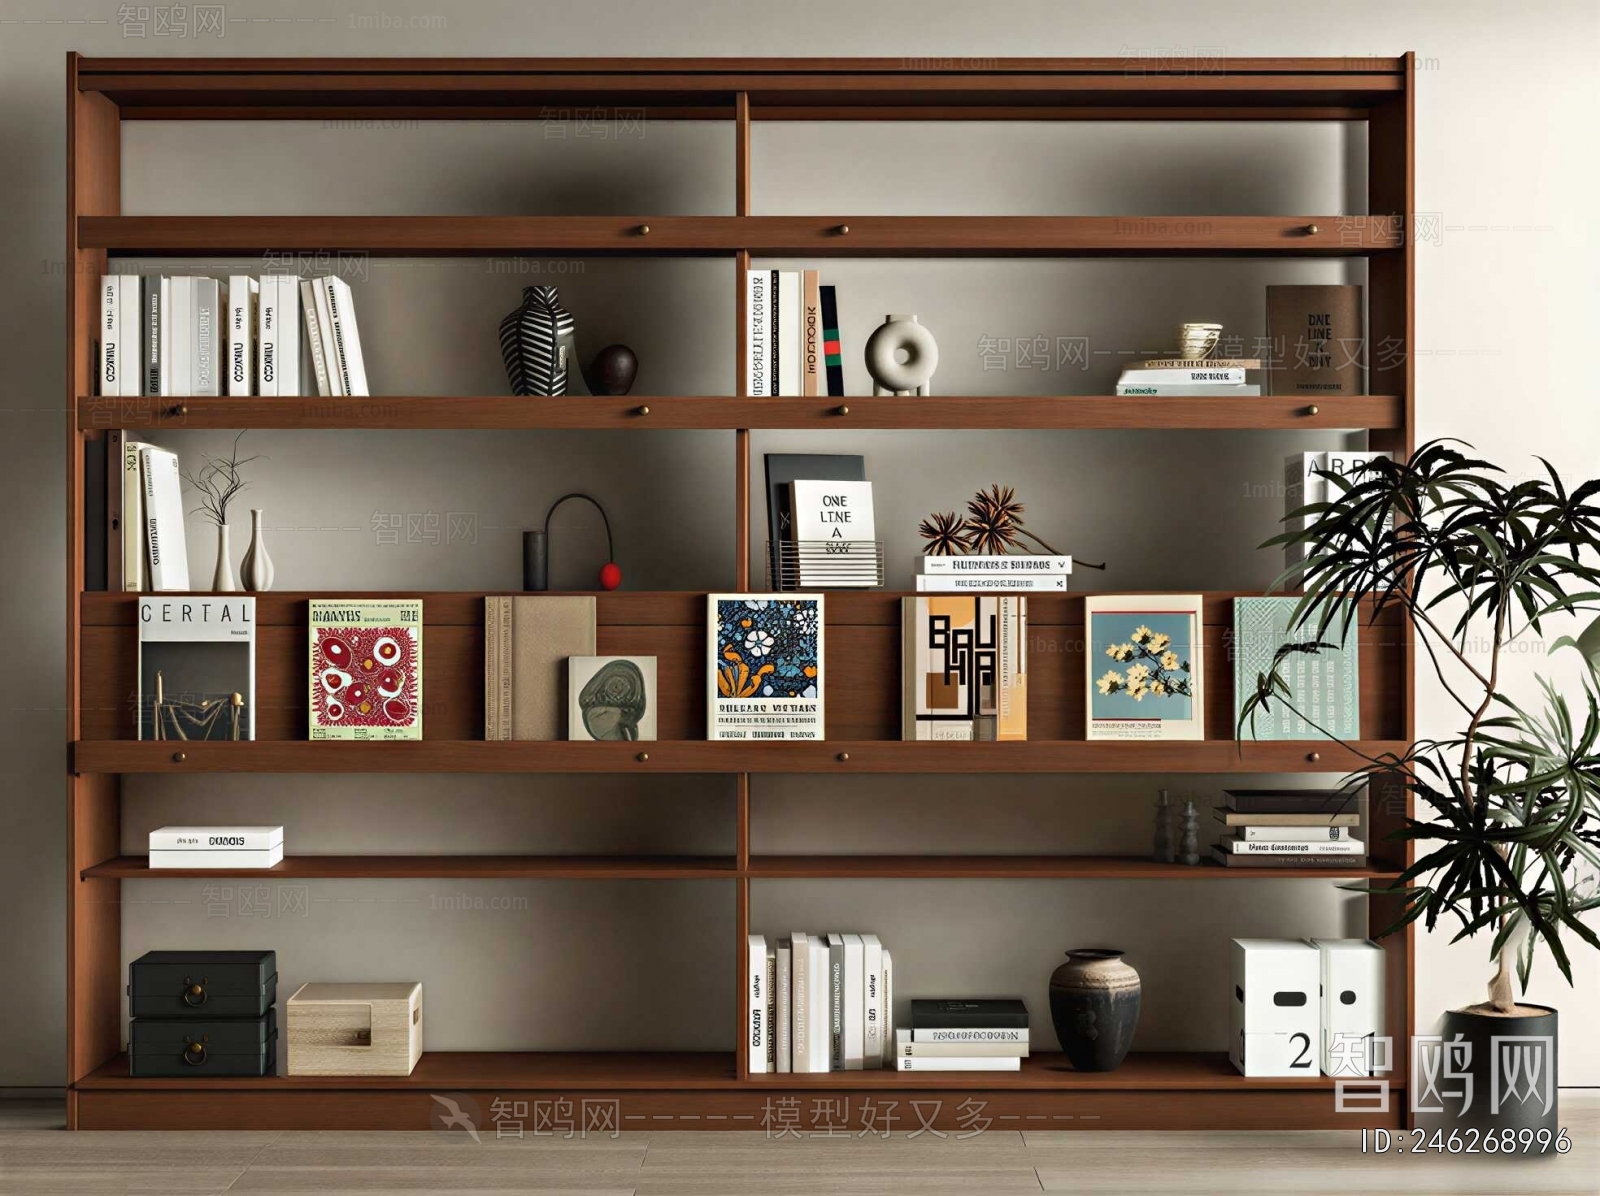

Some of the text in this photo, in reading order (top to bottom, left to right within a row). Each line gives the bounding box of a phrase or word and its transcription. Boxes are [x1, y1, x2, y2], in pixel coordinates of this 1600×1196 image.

[822, 495, 848, 507] ONE
[820, 511, 852, 523] LINE
[831, 527, 842, 538] A
[141, 604, 251, 622] CERTAL
[1289, 1032, 1313, 1069] 2
